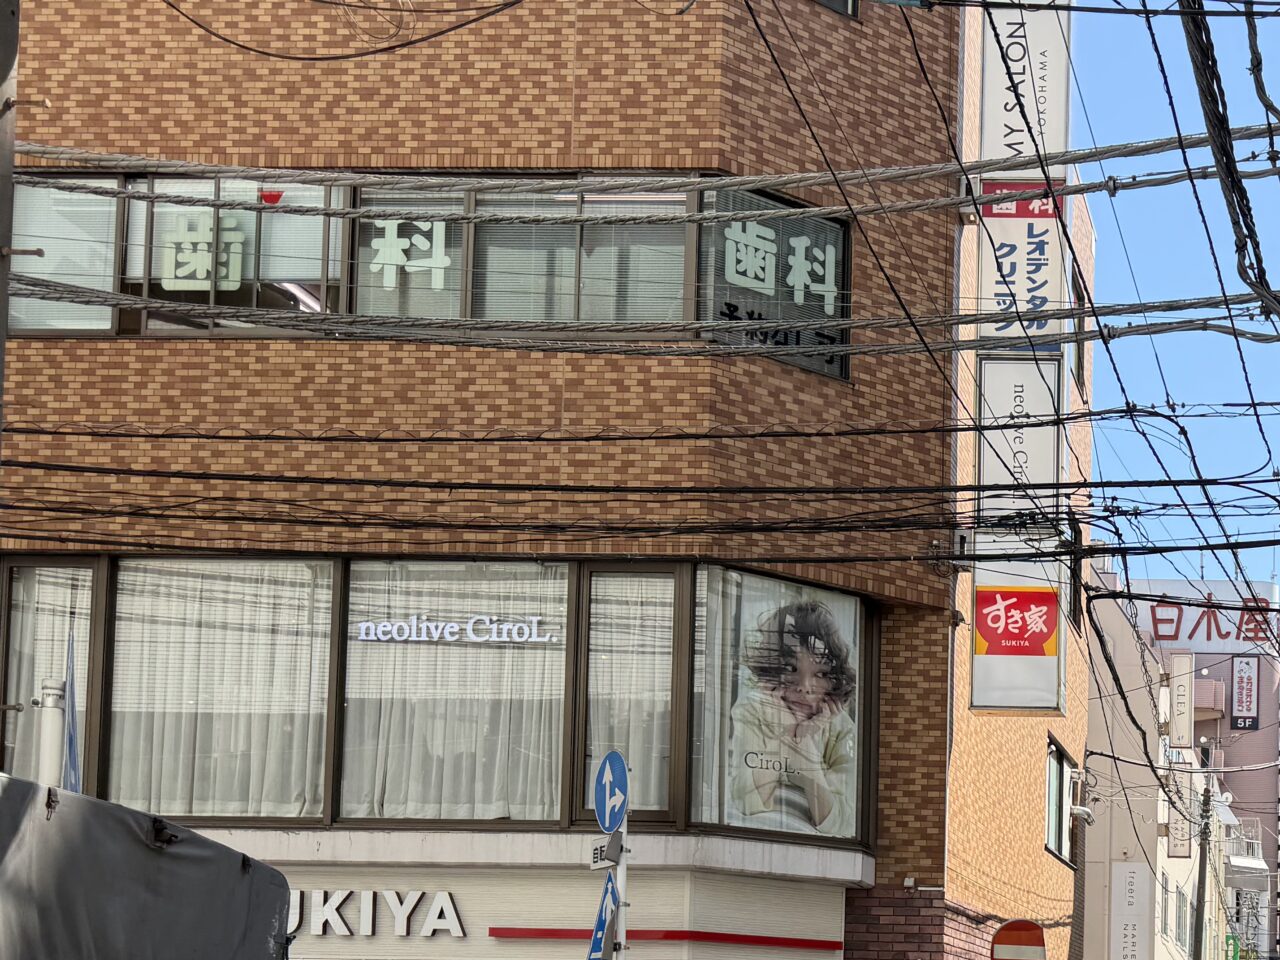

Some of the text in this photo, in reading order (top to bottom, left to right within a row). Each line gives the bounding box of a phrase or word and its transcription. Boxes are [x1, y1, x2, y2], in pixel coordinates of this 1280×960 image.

[1037, 50, 1048, 137] YOKOHAMA
[724, 220, 838, 316] 歯科
[358, 615, 558, 643] neolive CiroL.
[982, 593, 1048, 638] すき家
[1151, 592, 1271, 642] 白木屋
[1001, 639, 1029, 647] SUKIYA
[1237, 718, 1252, 728] 5F
[744, 751, 800, 775] CiroL.
